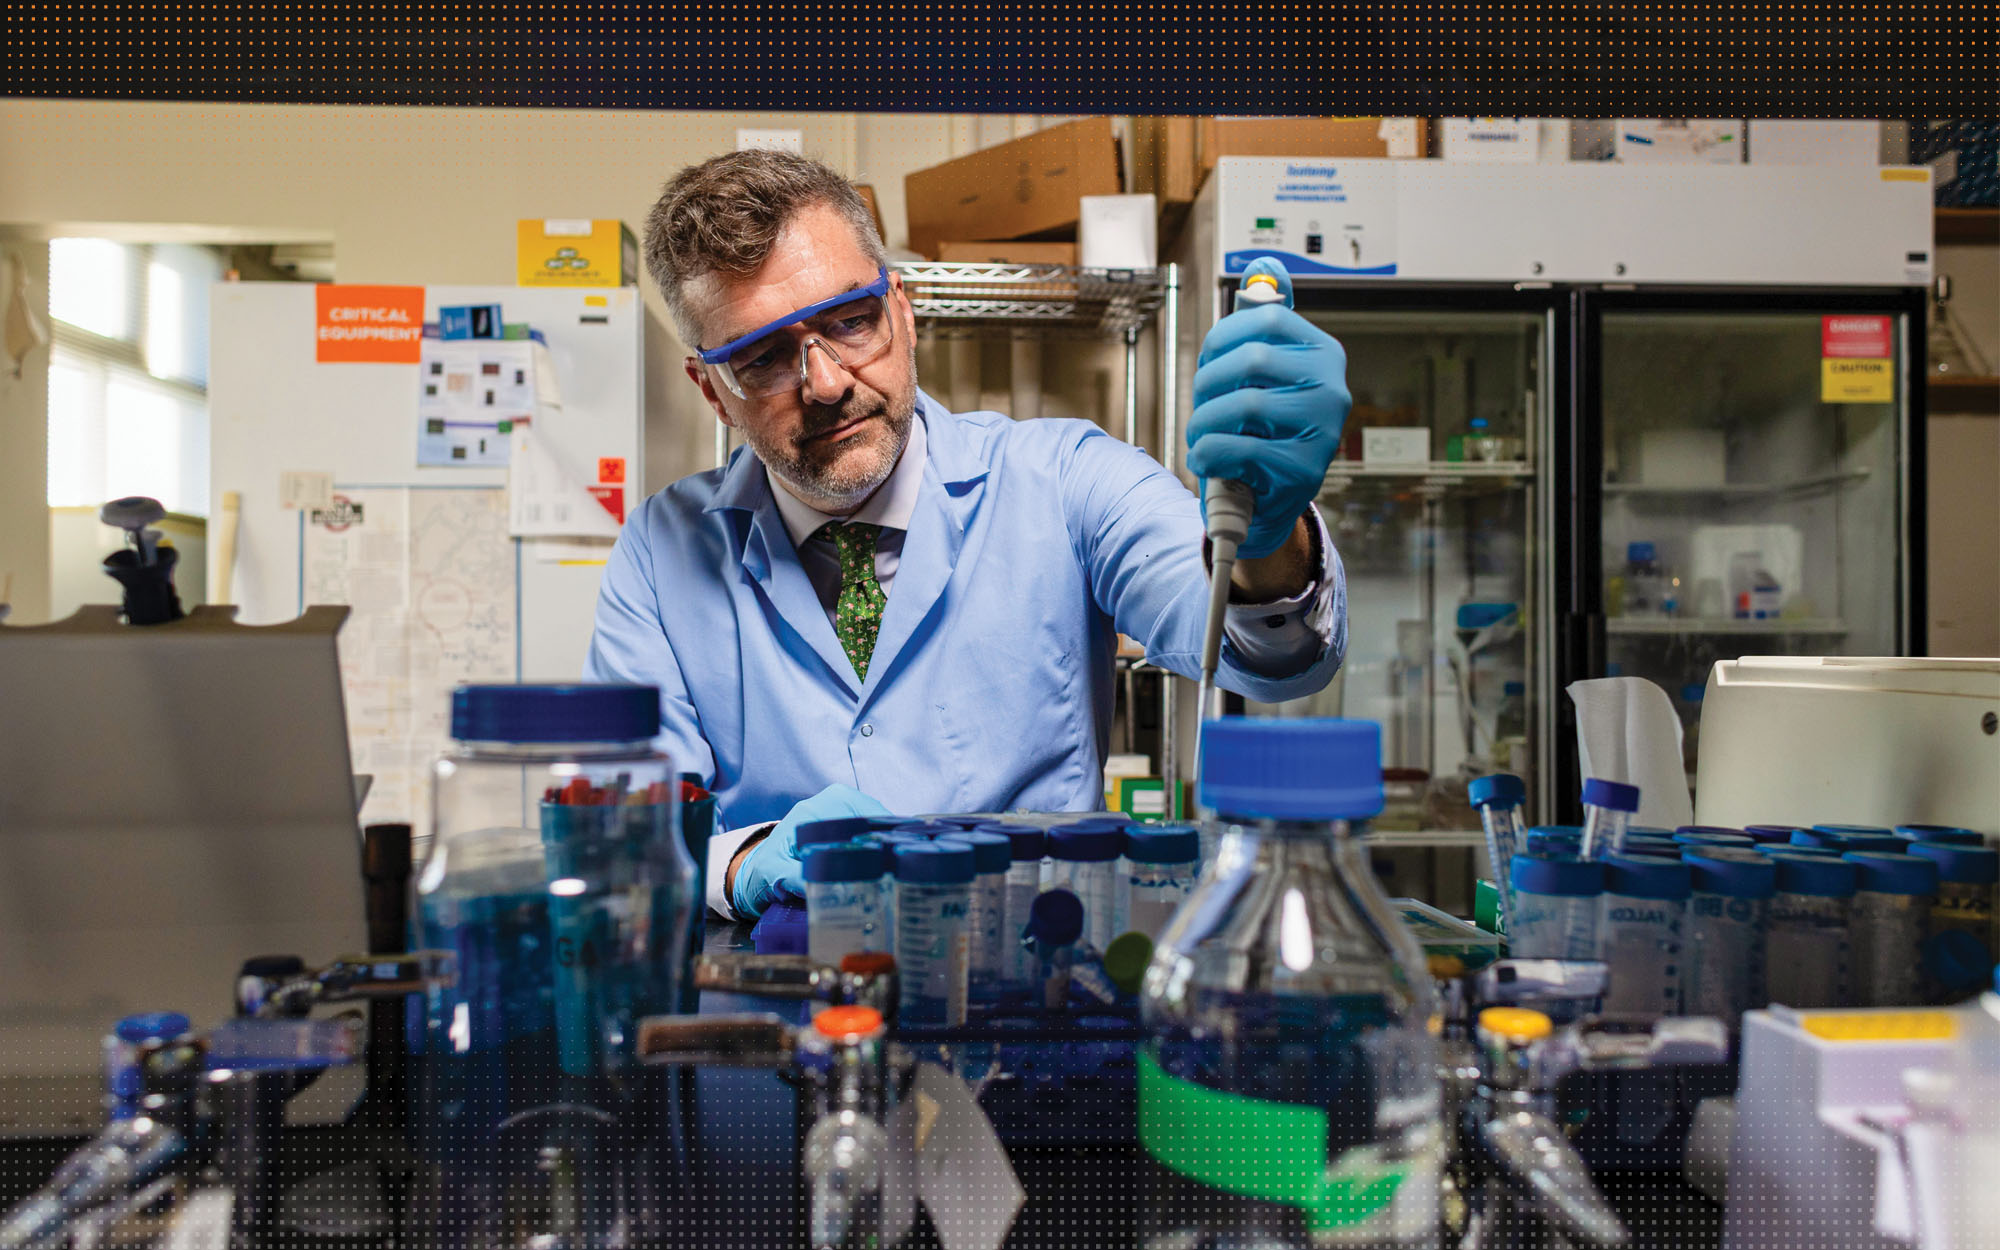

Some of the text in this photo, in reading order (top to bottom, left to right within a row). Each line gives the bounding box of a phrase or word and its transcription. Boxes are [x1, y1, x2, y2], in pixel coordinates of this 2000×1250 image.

[329, 306, 410, 322] CRITICAL
[319, 326, 420, 341] EQUIPMENT
[1831, 361, 1884, 374] CAUTION
